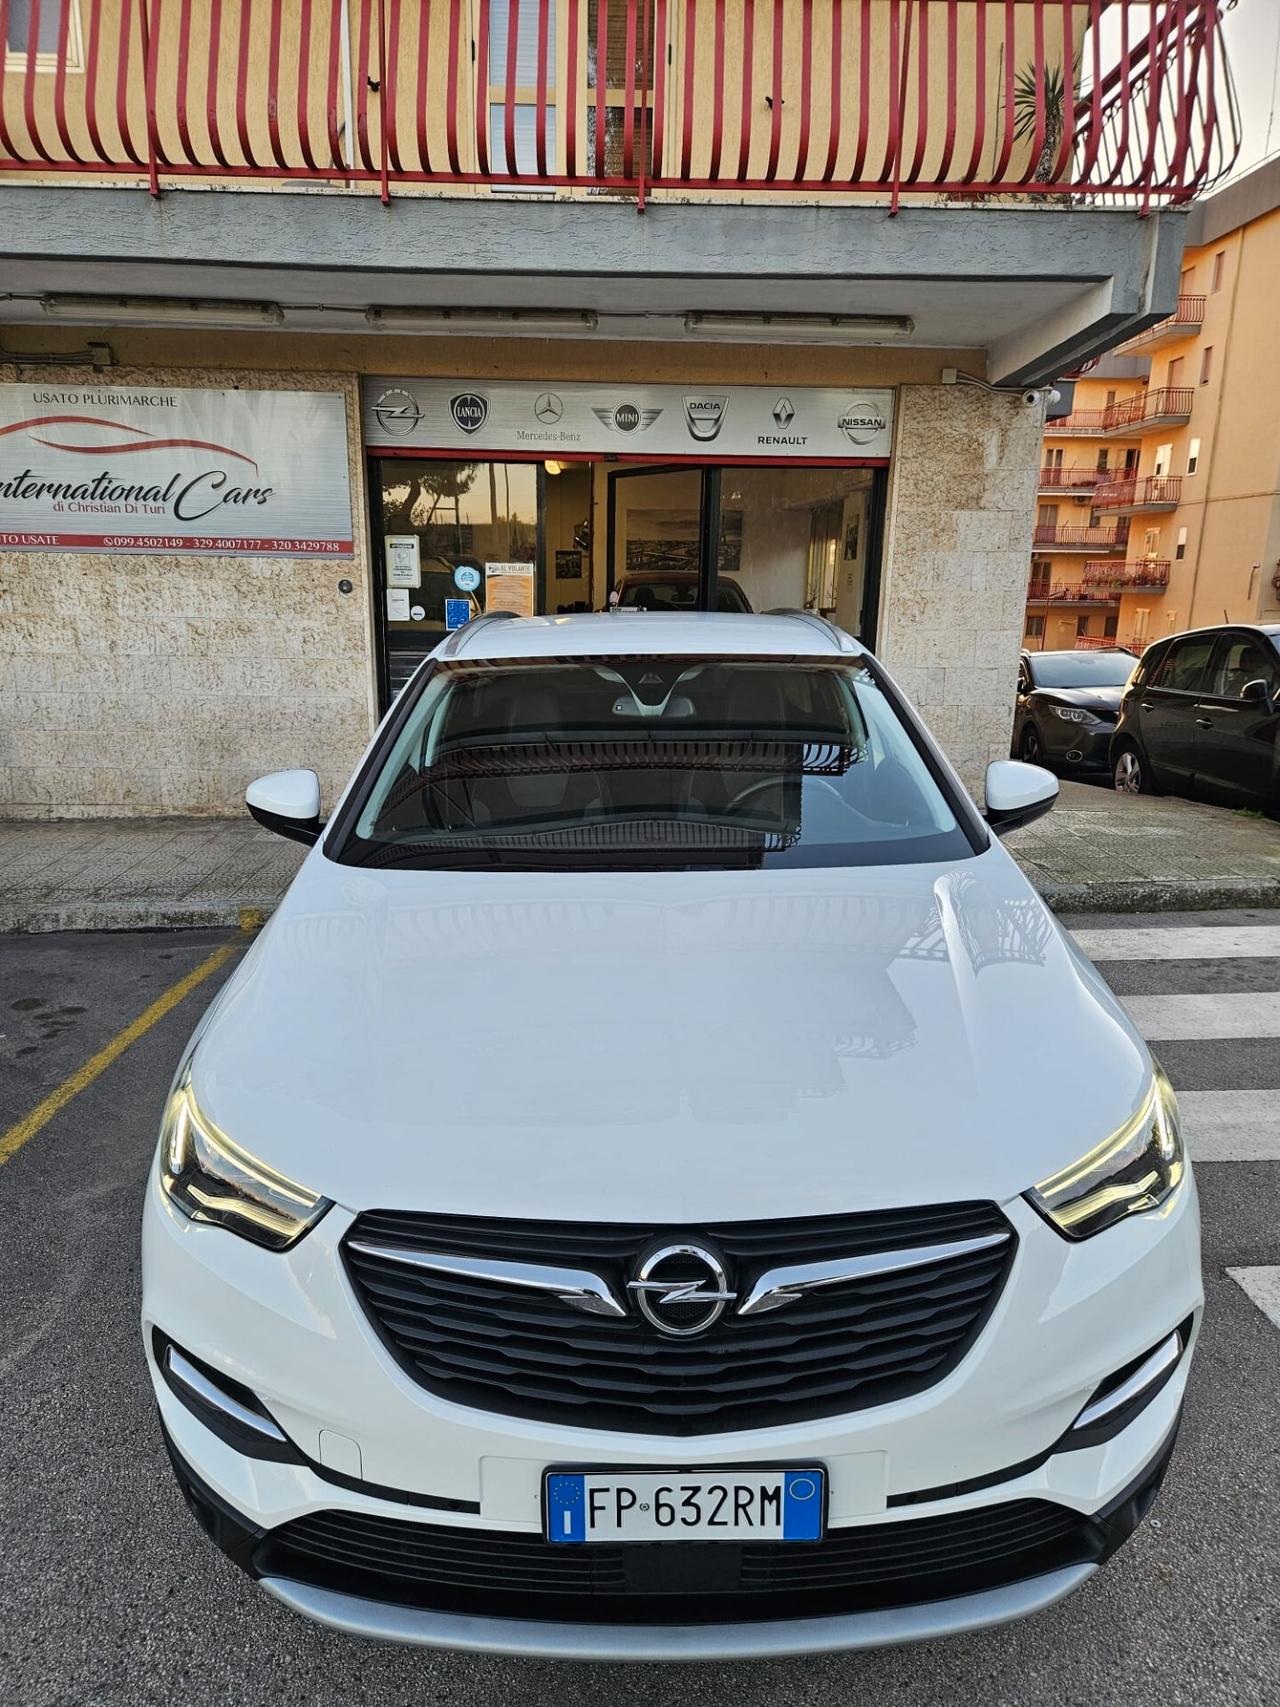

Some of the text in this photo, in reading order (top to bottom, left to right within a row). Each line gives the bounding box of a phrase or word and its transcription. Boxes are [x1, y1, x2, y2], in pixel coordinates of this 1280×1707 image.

[33, 392, 177, 408] USATO PLURIMARCHE
[689, 401, 721, 410] DACIA
[457, 405, 482, 418] LANCIA
[616, 412, 638, 423] MINI
[841, 417, 882, 427] NISSAN
[516, 430, 581, 442] Mercedes-Benz
[757, 436, 808, 445] RENAULT
[0, 469, 278, 521] nternational Cars
[53, 501, 165, 514] di Christian Di Turi
[0, 534, 18, 544] TO
[22, 535, 60, 545] USATE
[114, 536, 183, 548] 099.4502149
[193, 538, 261, 549] 329.4007177
[271, 540, 340, 551] 320.3429788
[588, 1486, 637, 1528] FP
[654, 1484, 782, 1527] 632RM
